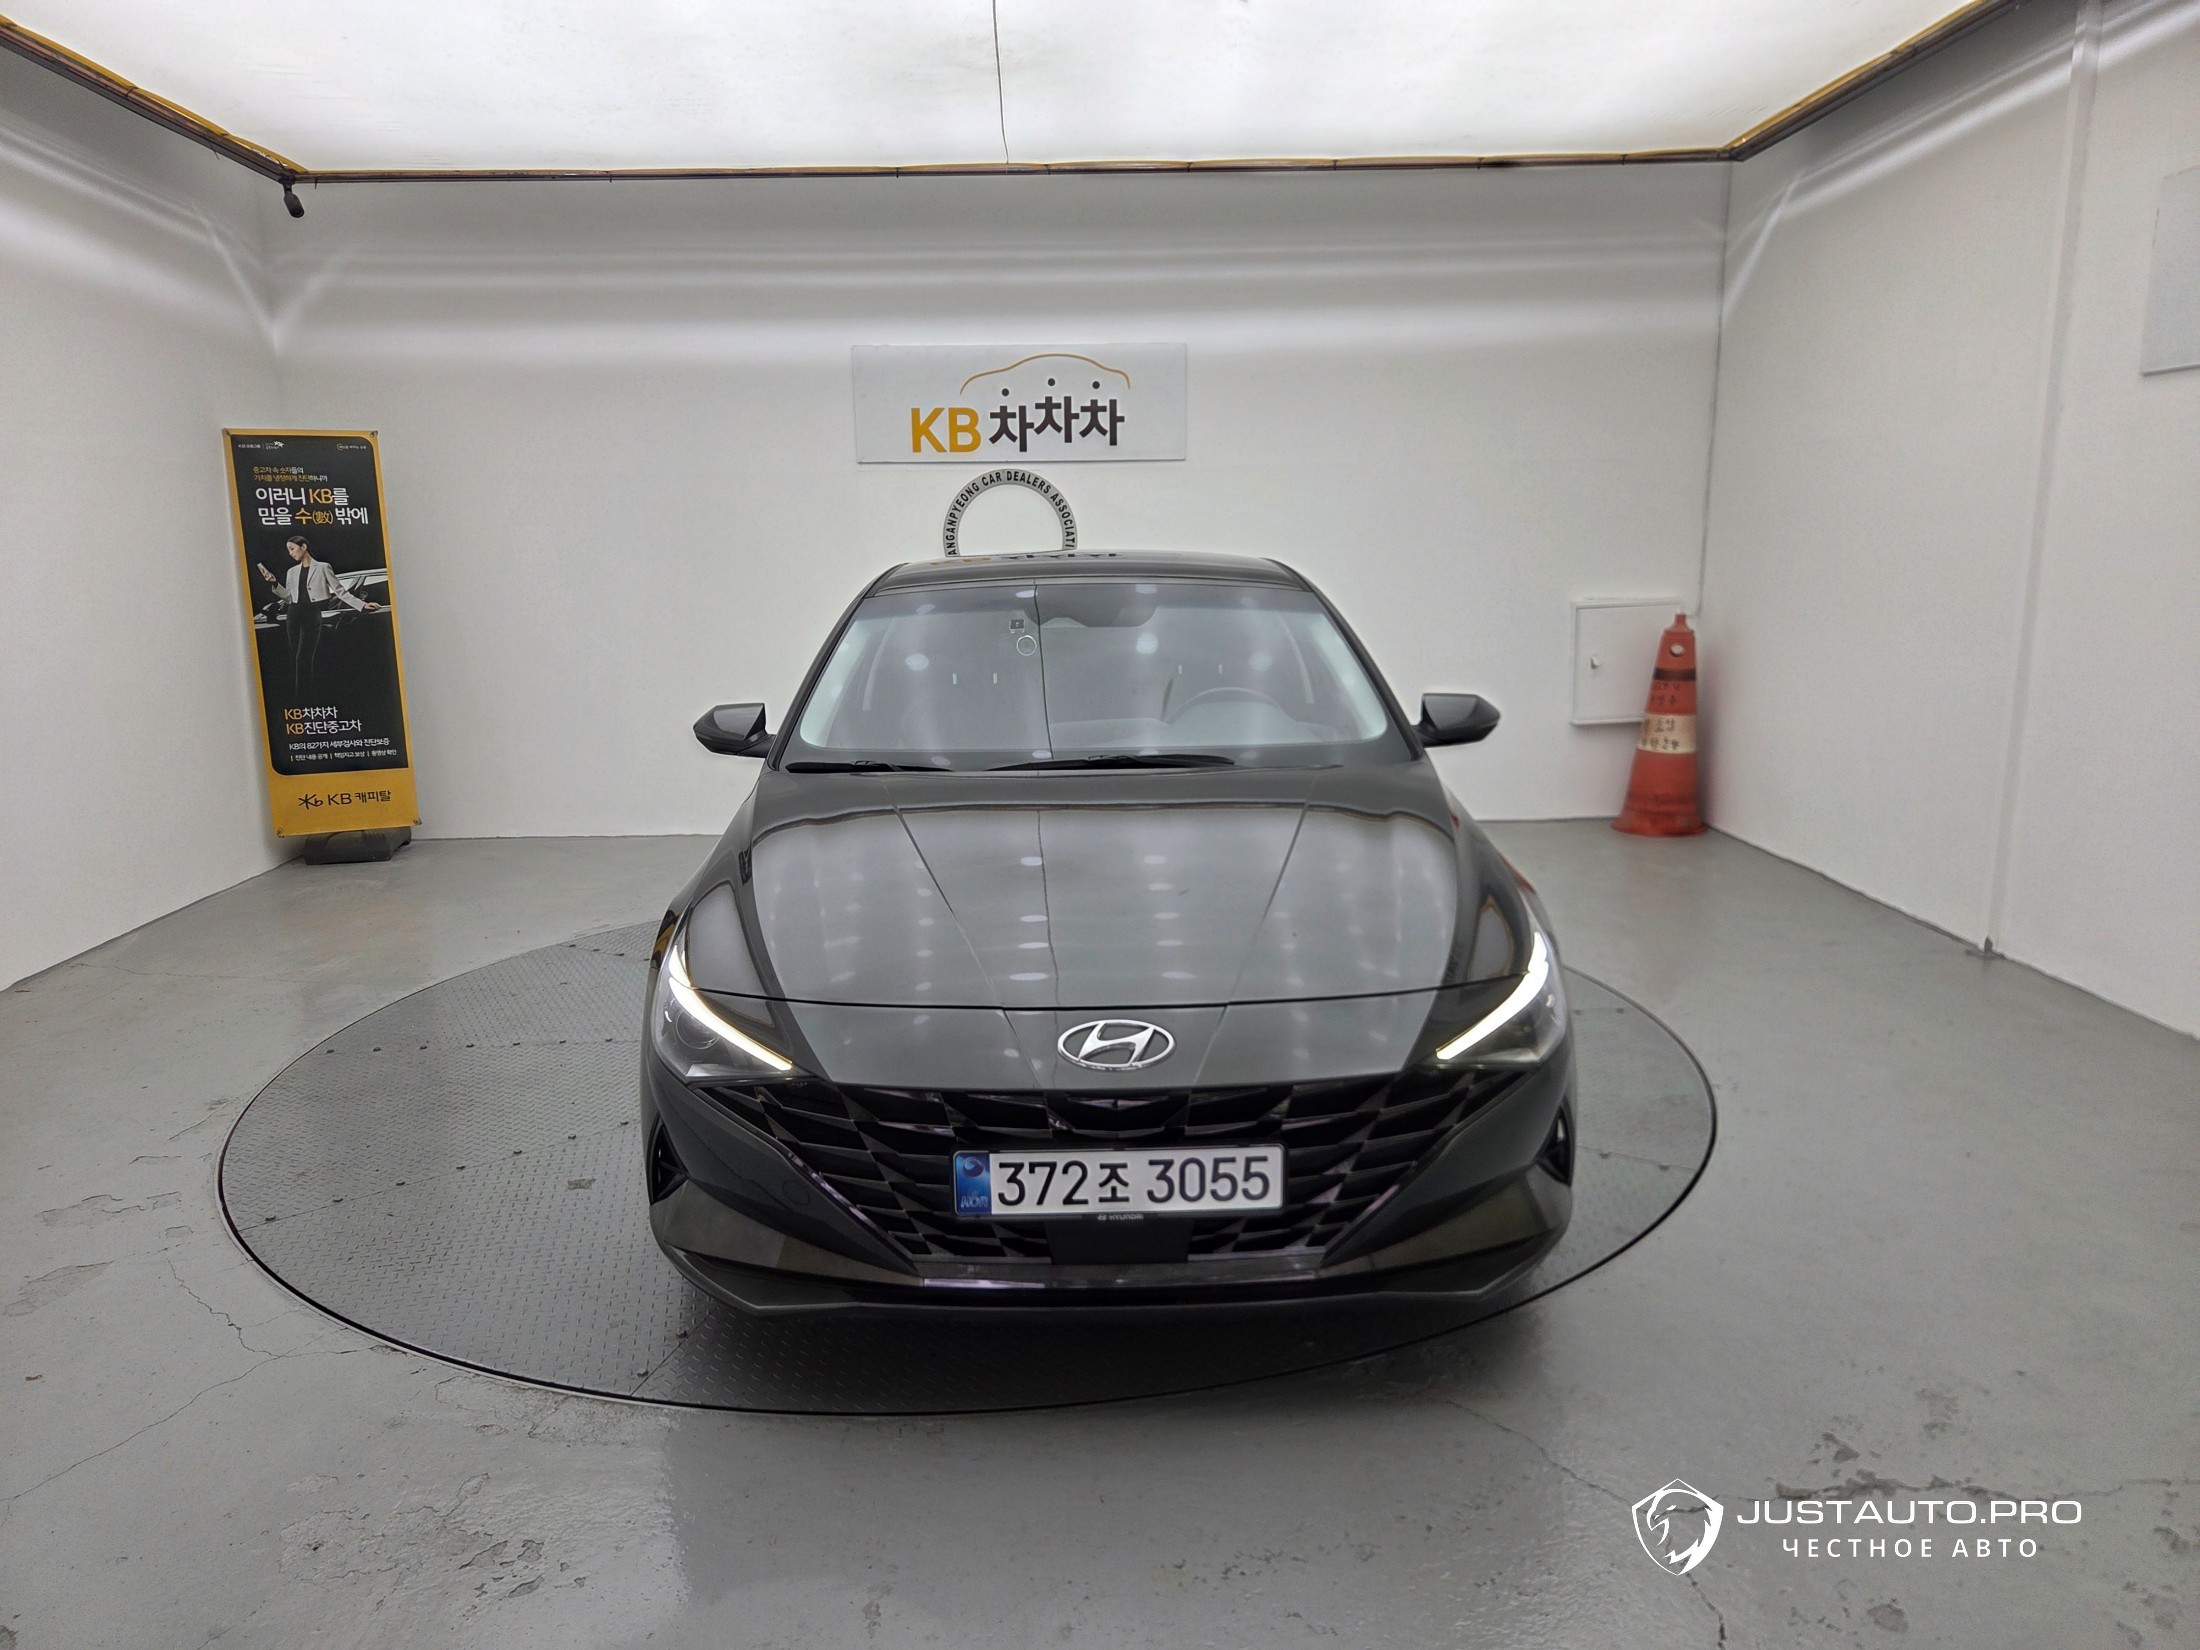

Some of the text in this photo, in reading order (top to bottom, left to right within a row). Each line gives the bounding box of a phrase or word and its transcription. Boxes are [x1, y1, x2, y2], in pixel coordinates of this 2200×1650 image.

[981, 471, 1003, 486] CAR
[1006, 470, 1051, 494] DEALERS
[255, 487, 349, 506] 이러니 KB를
[259, 508, 292, 526] 믿을
[335, 507, 369, 525] 밖에
[284, 706, 338, 720] KB차차차
[286, 720, 362, 735] KB진단중고차
[289, 742, 306, 751] KB의
[306, 741, 330, 750] 82가지
[327, 793, 352, 805] KB
[354, 790, 392, 804] 캐피탈
[997, 1156, 1270, 1207] 372조 3055
